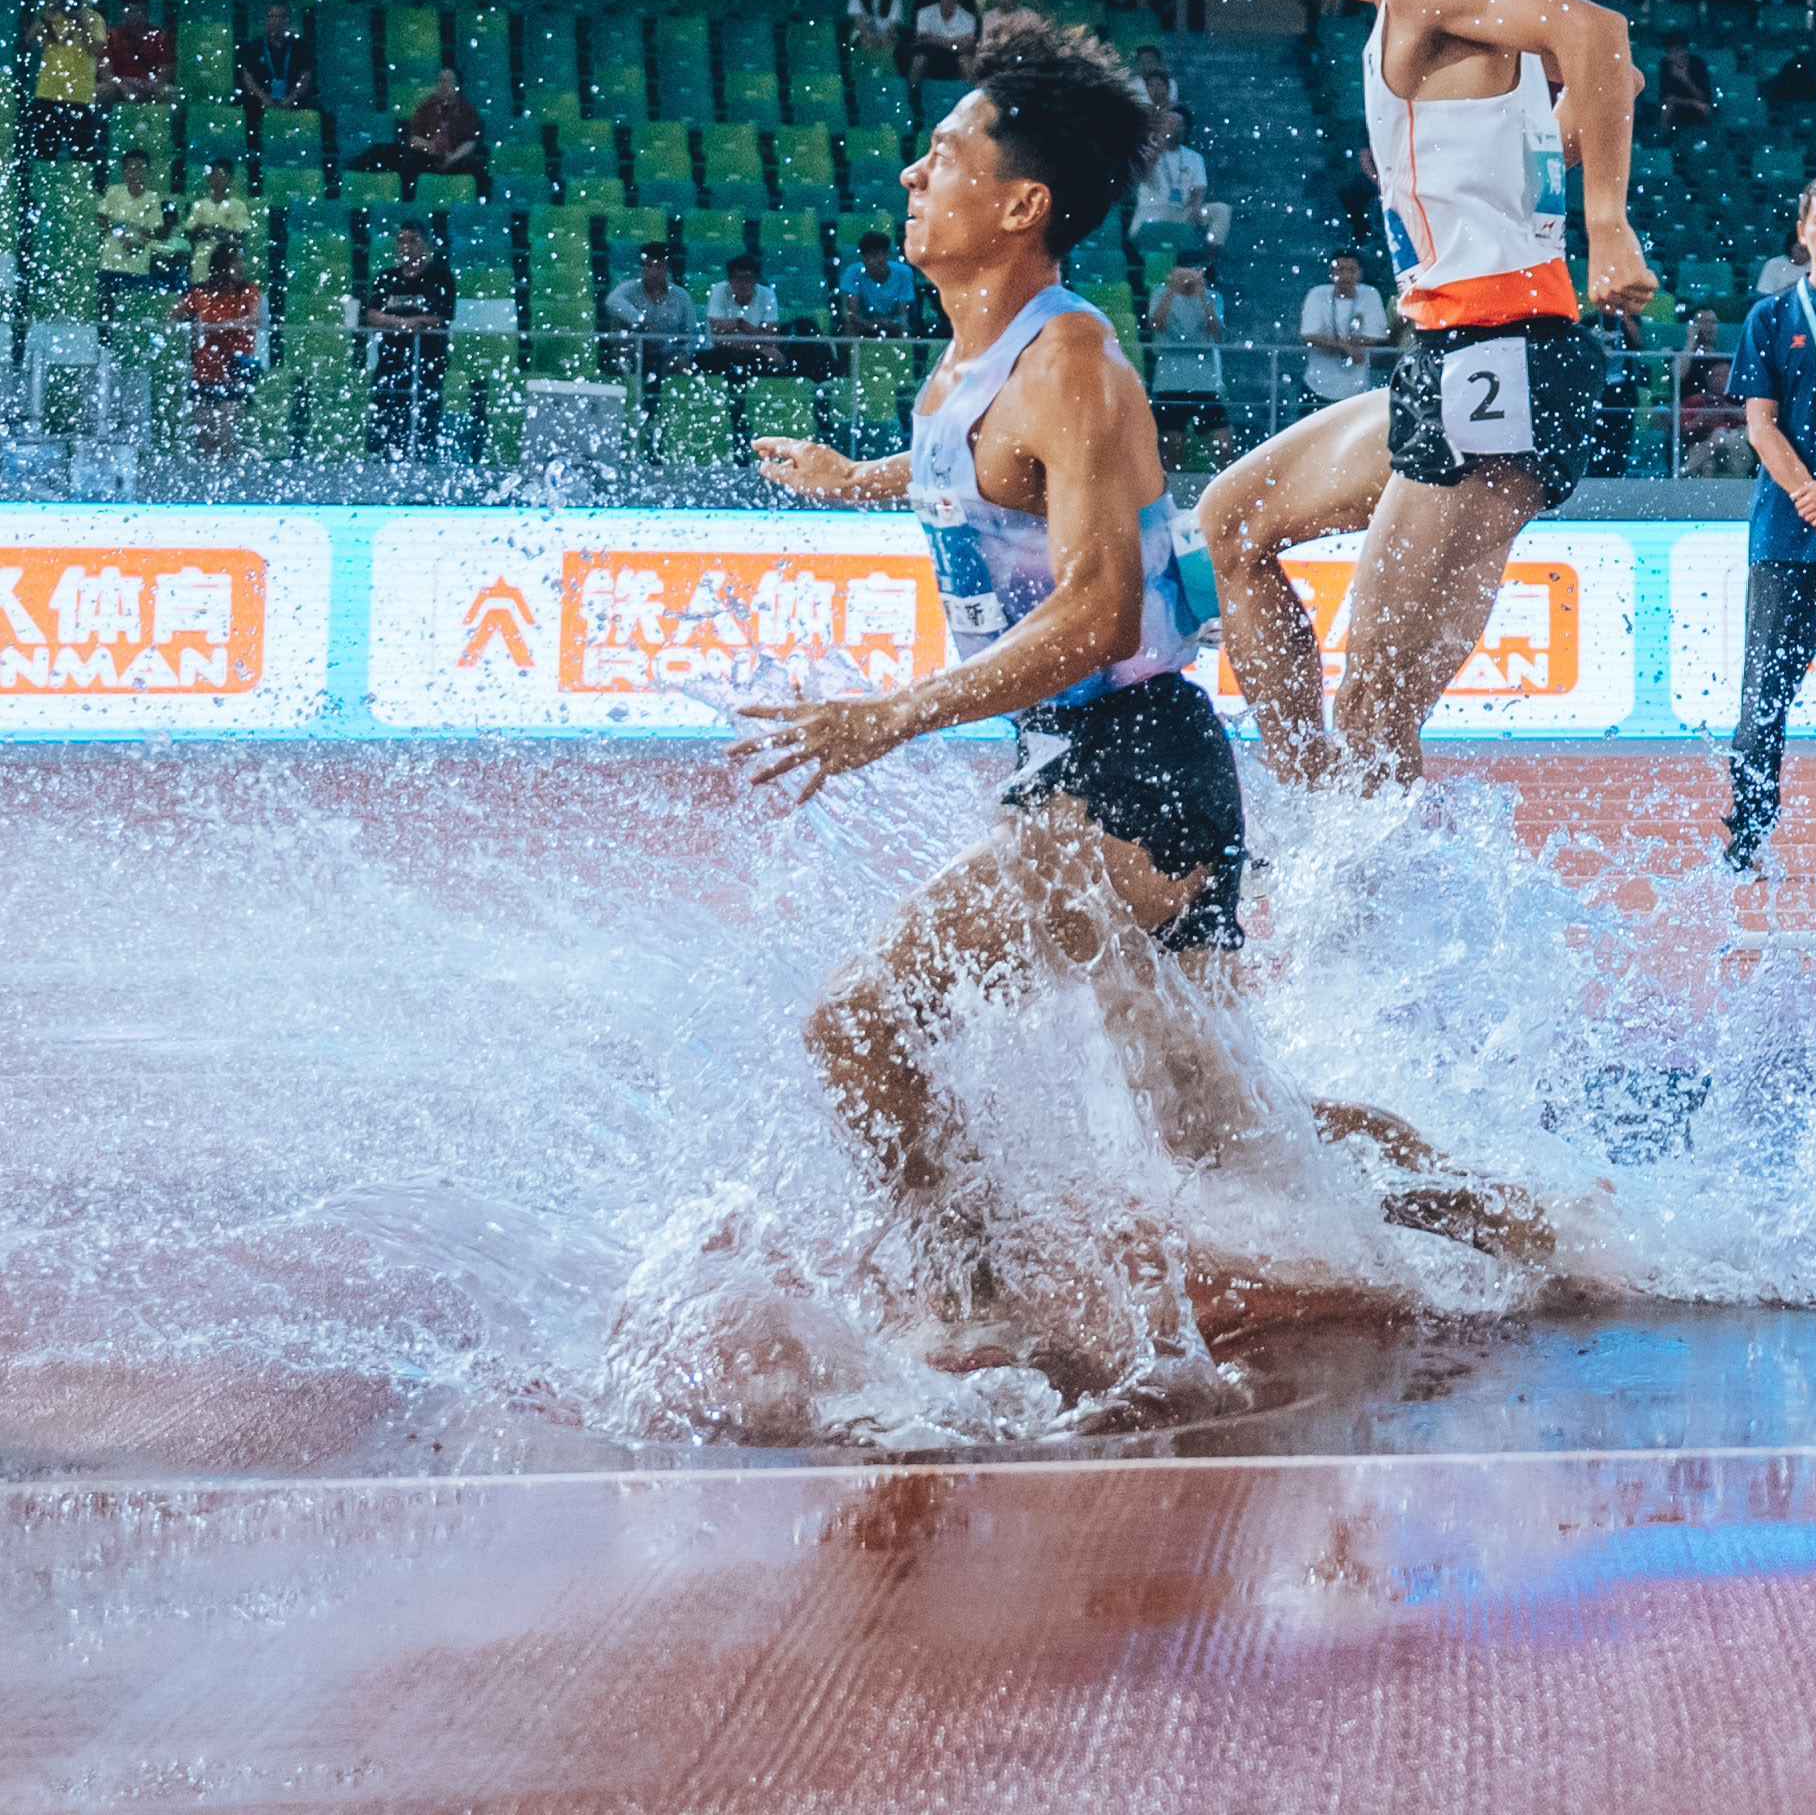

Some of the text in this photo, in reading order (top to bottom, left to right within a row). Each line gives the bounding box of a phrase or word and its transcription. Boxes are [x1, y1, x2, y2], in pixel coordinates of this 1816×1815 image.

[1466, 370, 1506, 422] 2
[580, 569, 916, 647] 铁人体育
